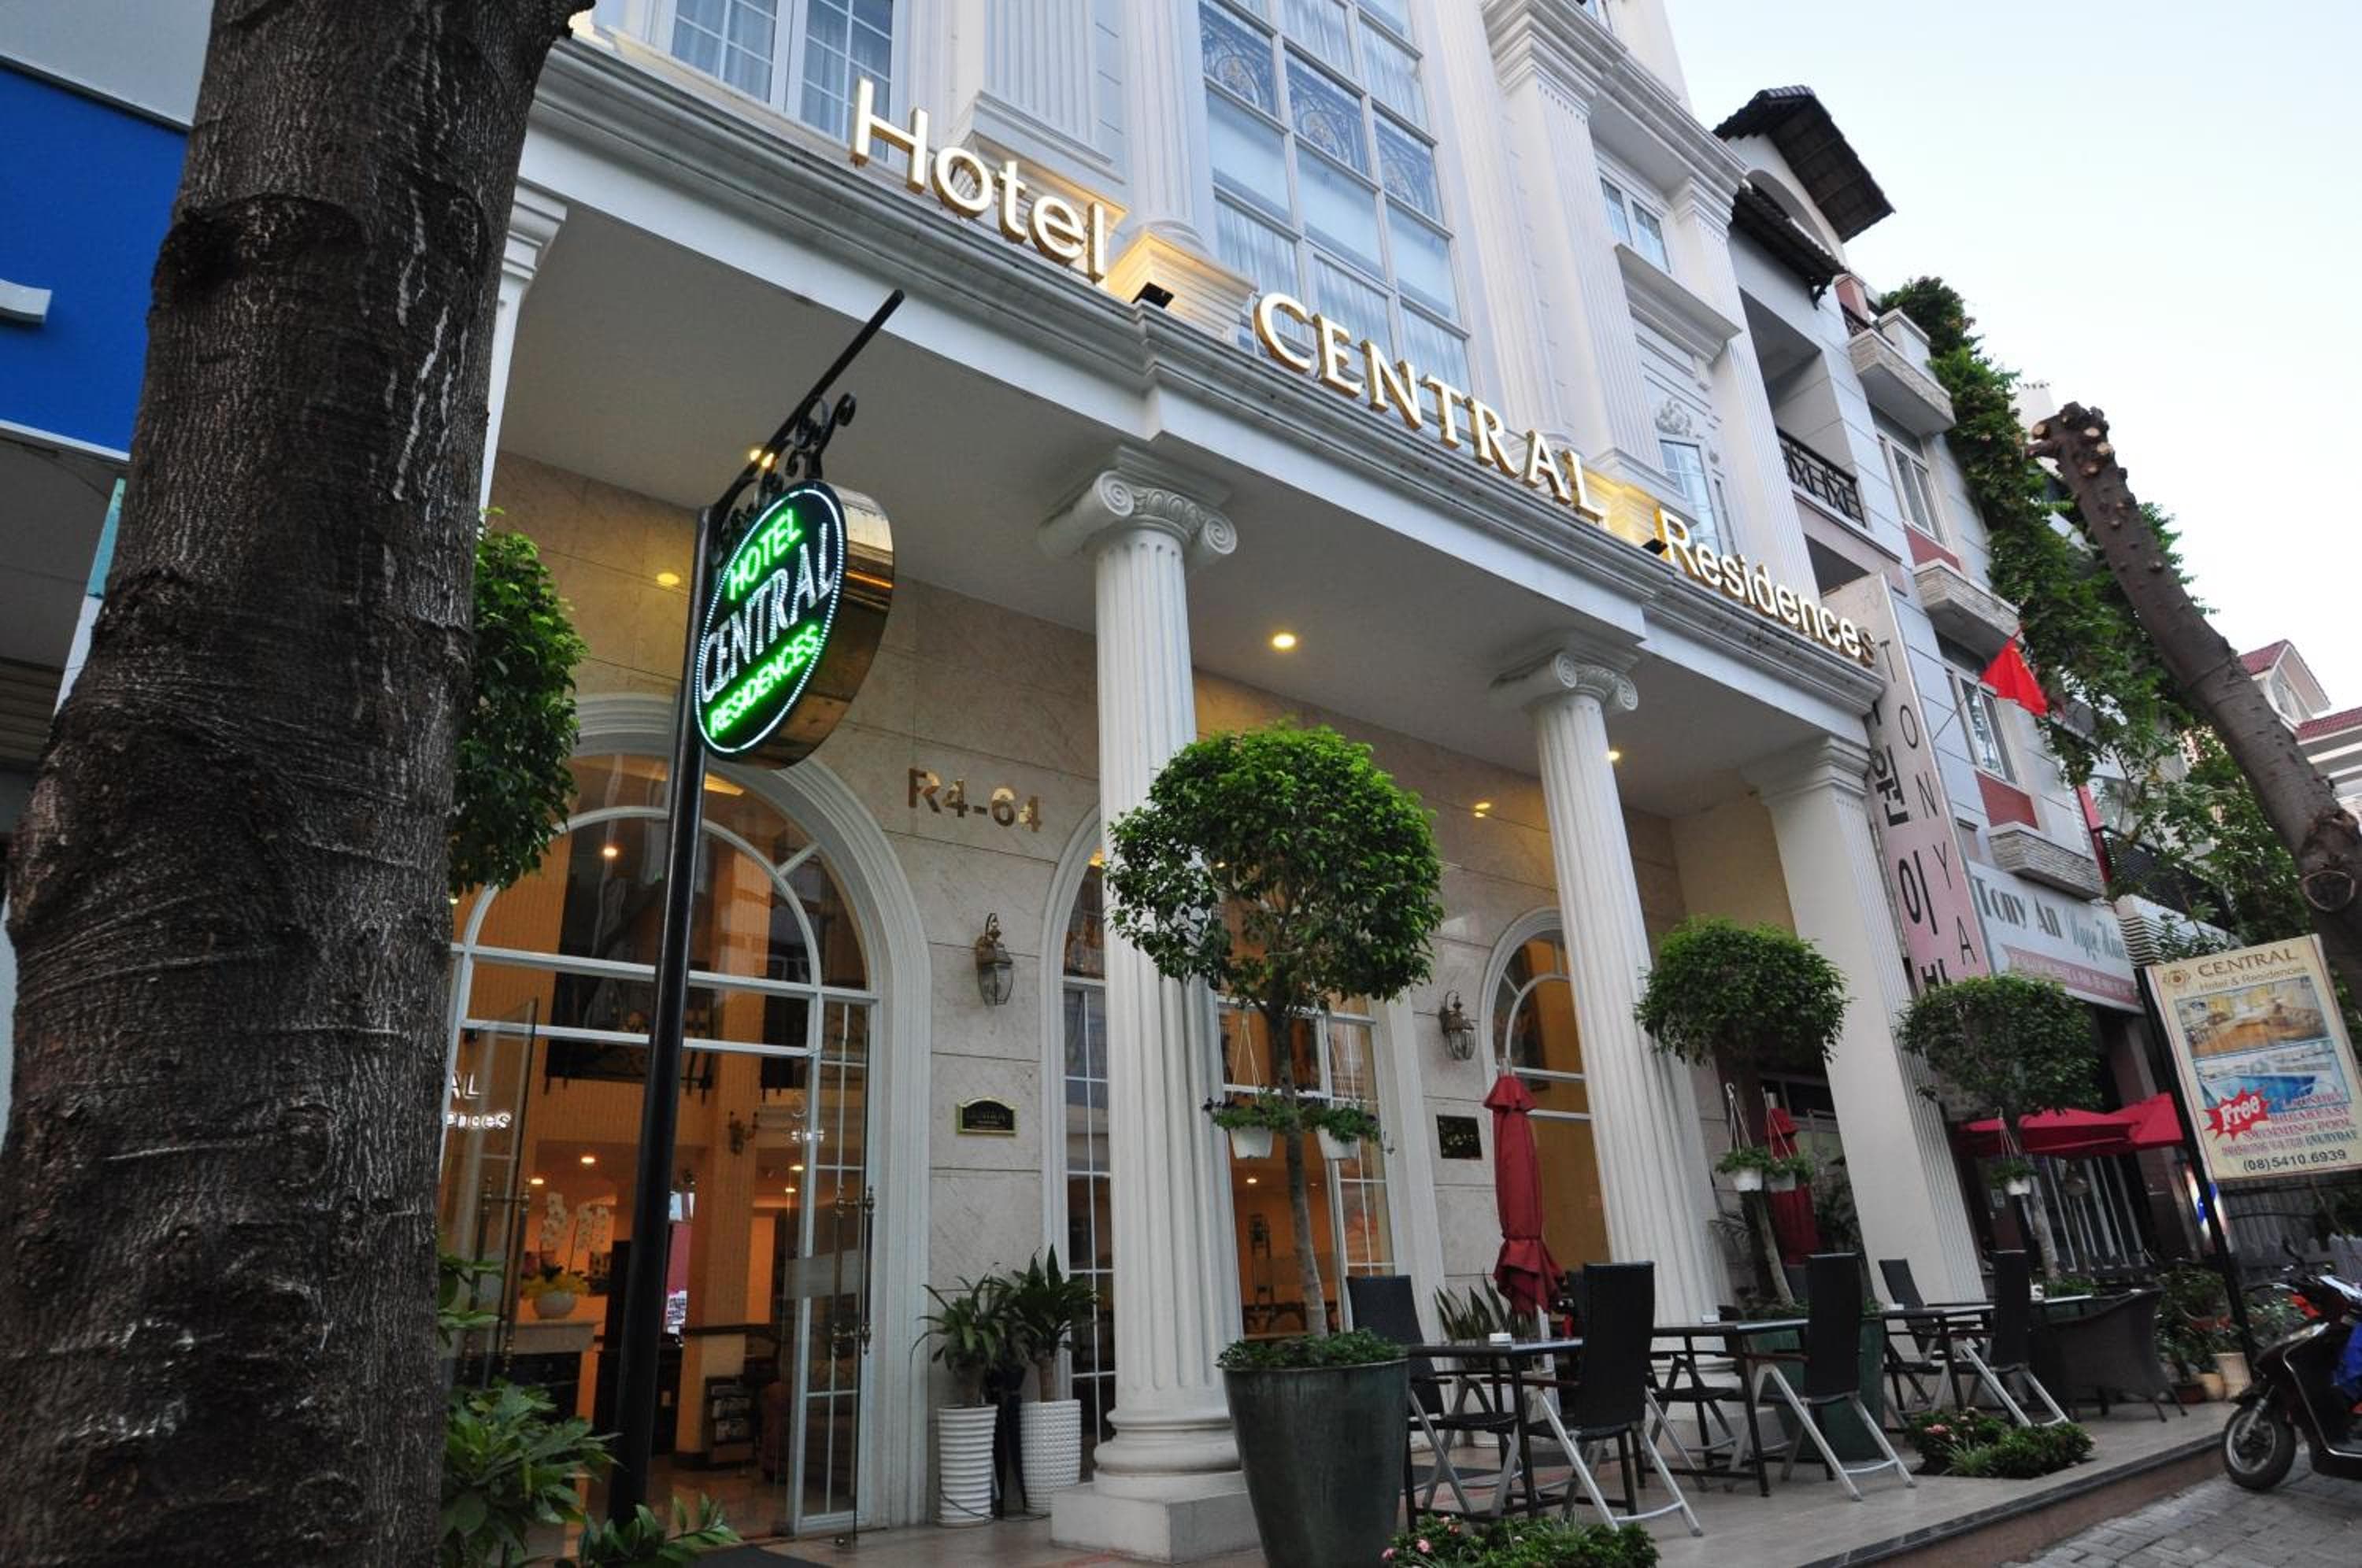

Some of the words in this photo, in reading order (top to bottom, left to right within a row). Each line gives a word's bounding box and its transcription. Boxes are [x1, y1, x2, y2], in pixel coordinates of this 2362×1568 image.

[850, 76, 1105, 284] Hotel
[1253, 291, 1608, 523] CENTRAL
[1655, 506, 1875, 668] Residences
[729, 508, 803, 600] HOTEL
[701, 522, 836, 704] CENTRAL
[709, 623, 820, 738] RESIDENCES
[1972, 875, 2027, 930] Tony
[2034, 894, 2063, 940] An
[2198, 947, 2299, 978] CENTRAL
[2219, 1095, 2260, 1131] Free
[2244, 1148, 2347, 1173] (08)5410.6939
